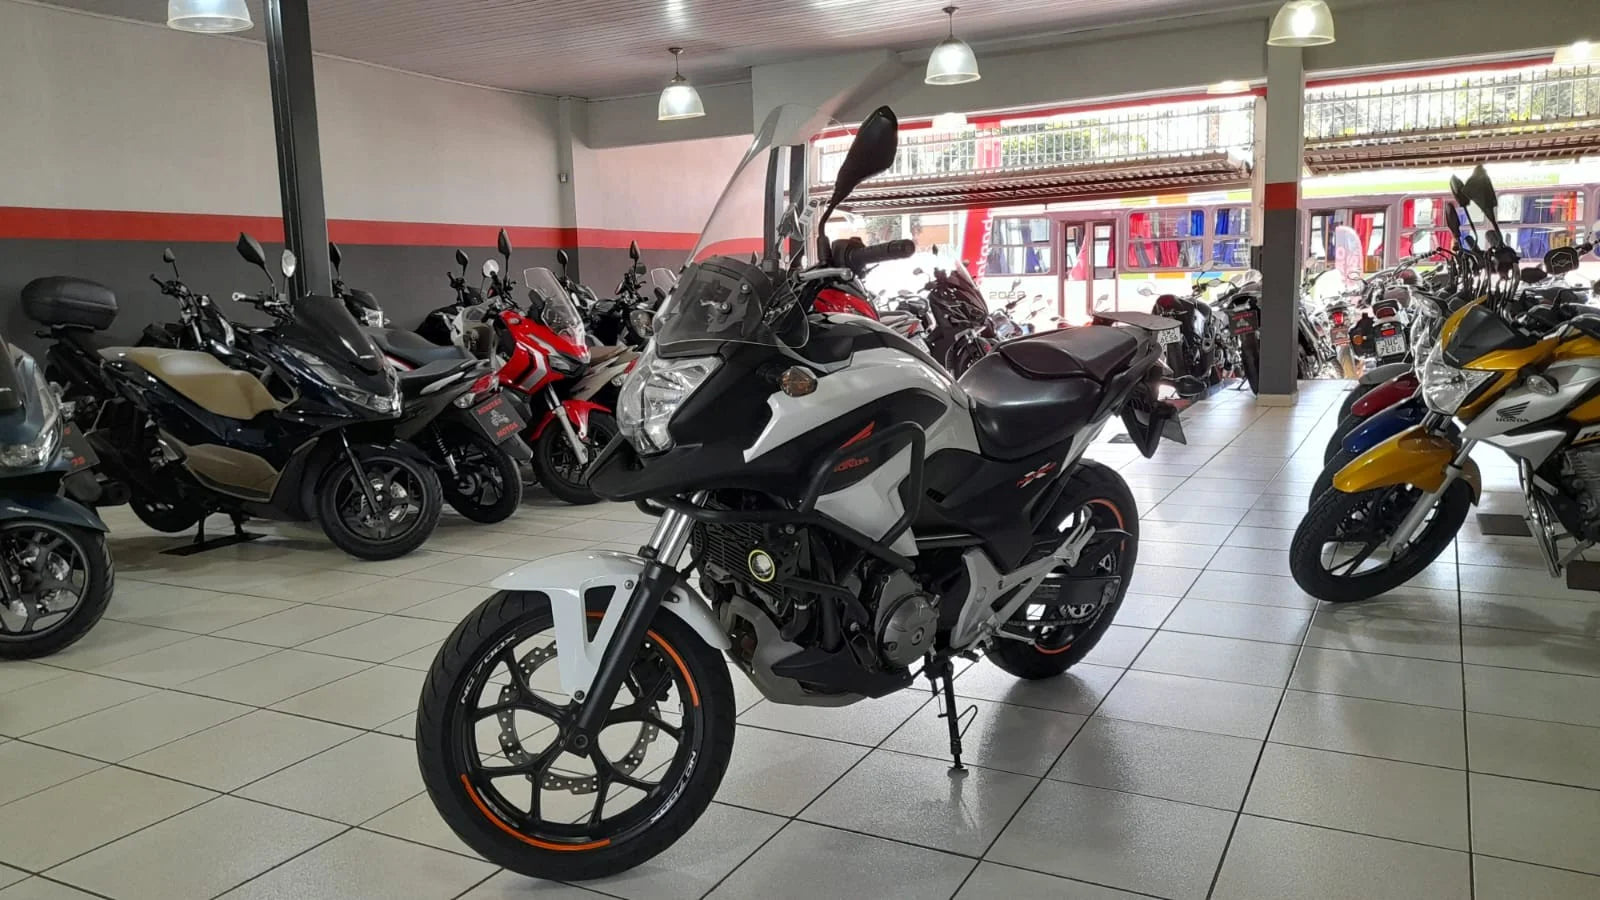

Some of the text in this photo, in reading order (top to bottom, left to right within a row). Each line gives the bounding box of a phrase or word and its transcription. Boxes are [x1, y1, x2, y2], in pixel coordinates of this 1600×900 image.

[461, 633, 517, 704] NC 700X
[650, 750, 697, 825] NC 700X
